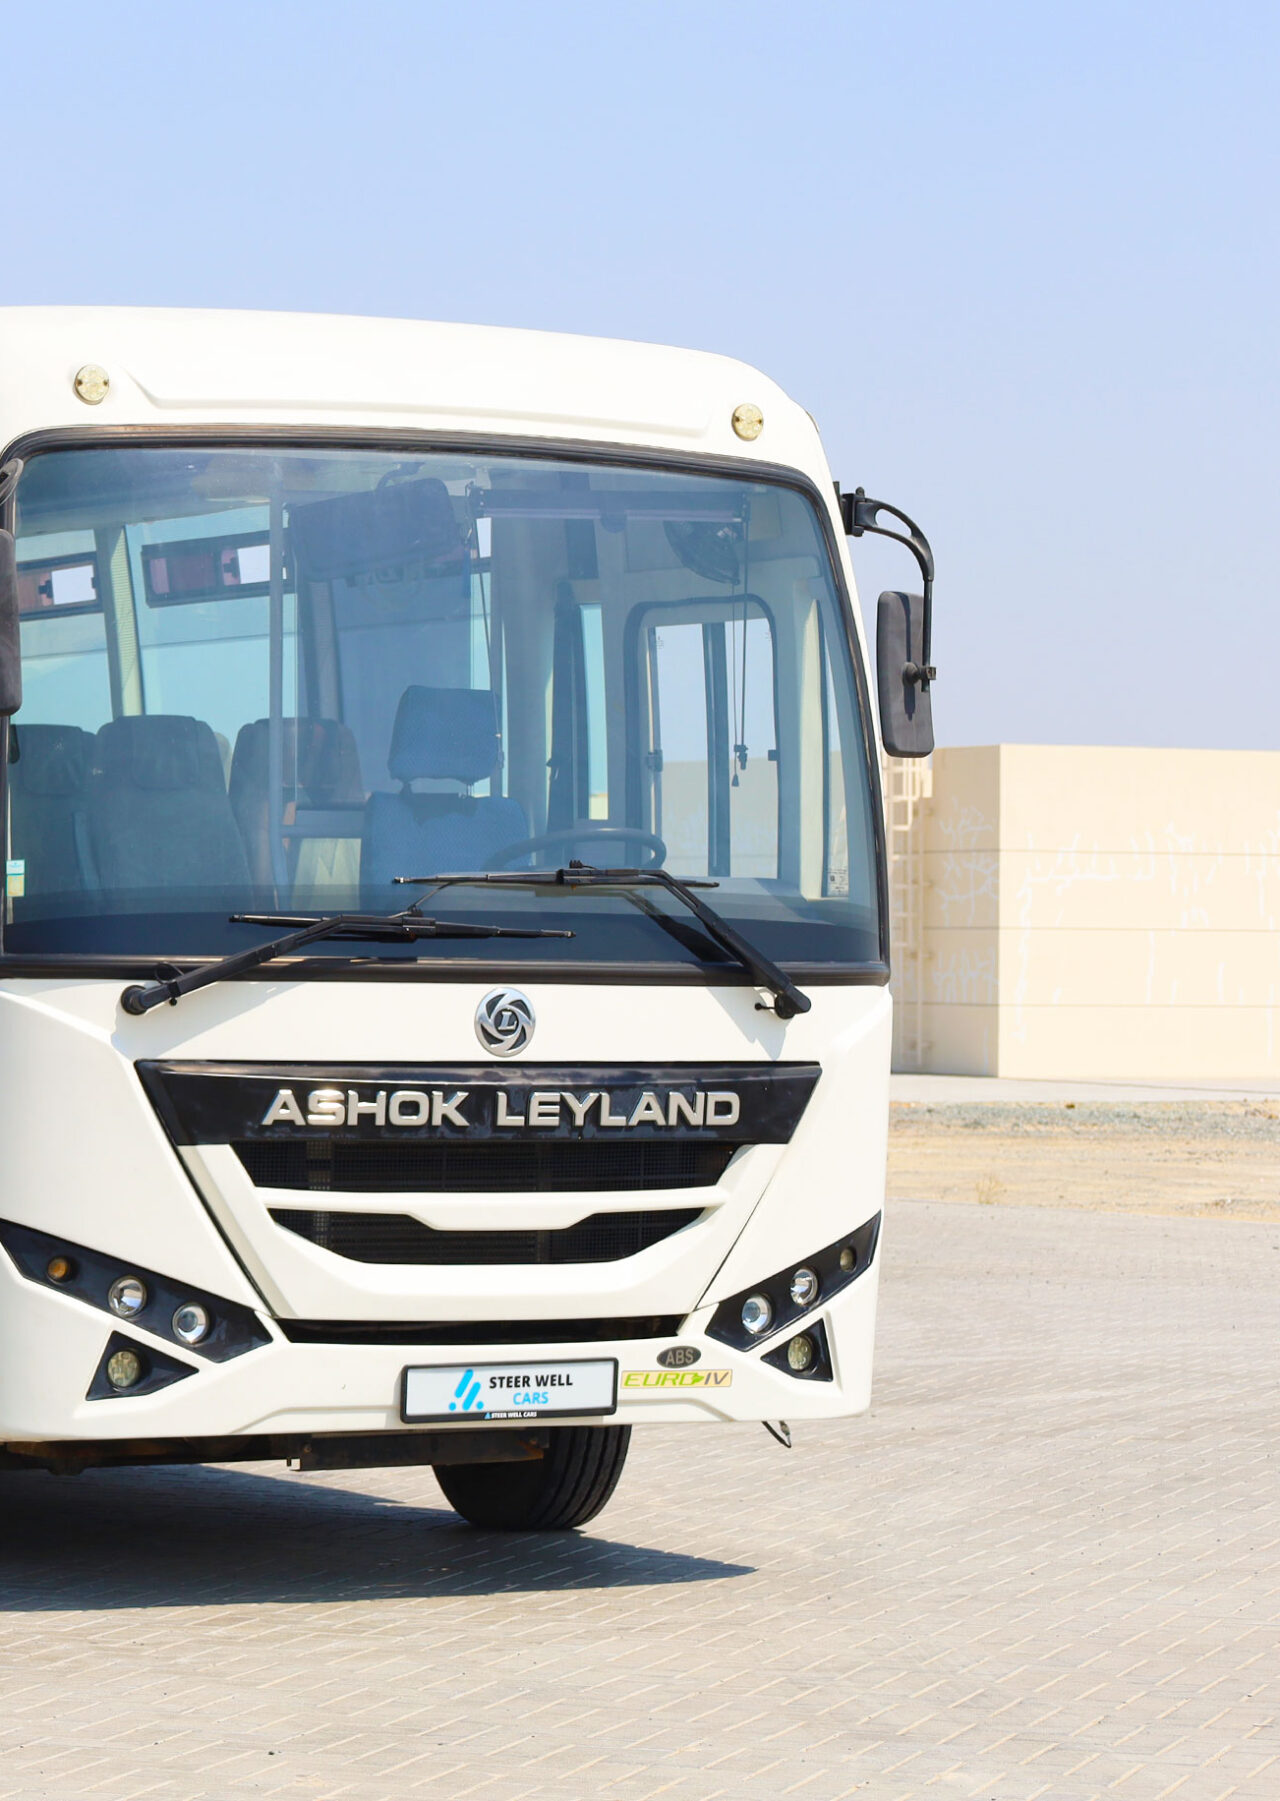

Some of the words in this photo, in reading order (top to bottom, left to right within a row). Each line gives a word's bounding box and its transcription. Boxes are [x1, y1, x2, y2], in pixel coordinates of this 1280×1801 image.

[261, 1089, 470, 1126] ASHOK
[496, 1091, 740, 1126] LEYLAND
[665, 1349, 695, 1366] ABS
[489, 1375, 531, 1389] STEER
[535, 1373, 573, 1387] WELL
[513, 1392, 549, 1405] CARS
